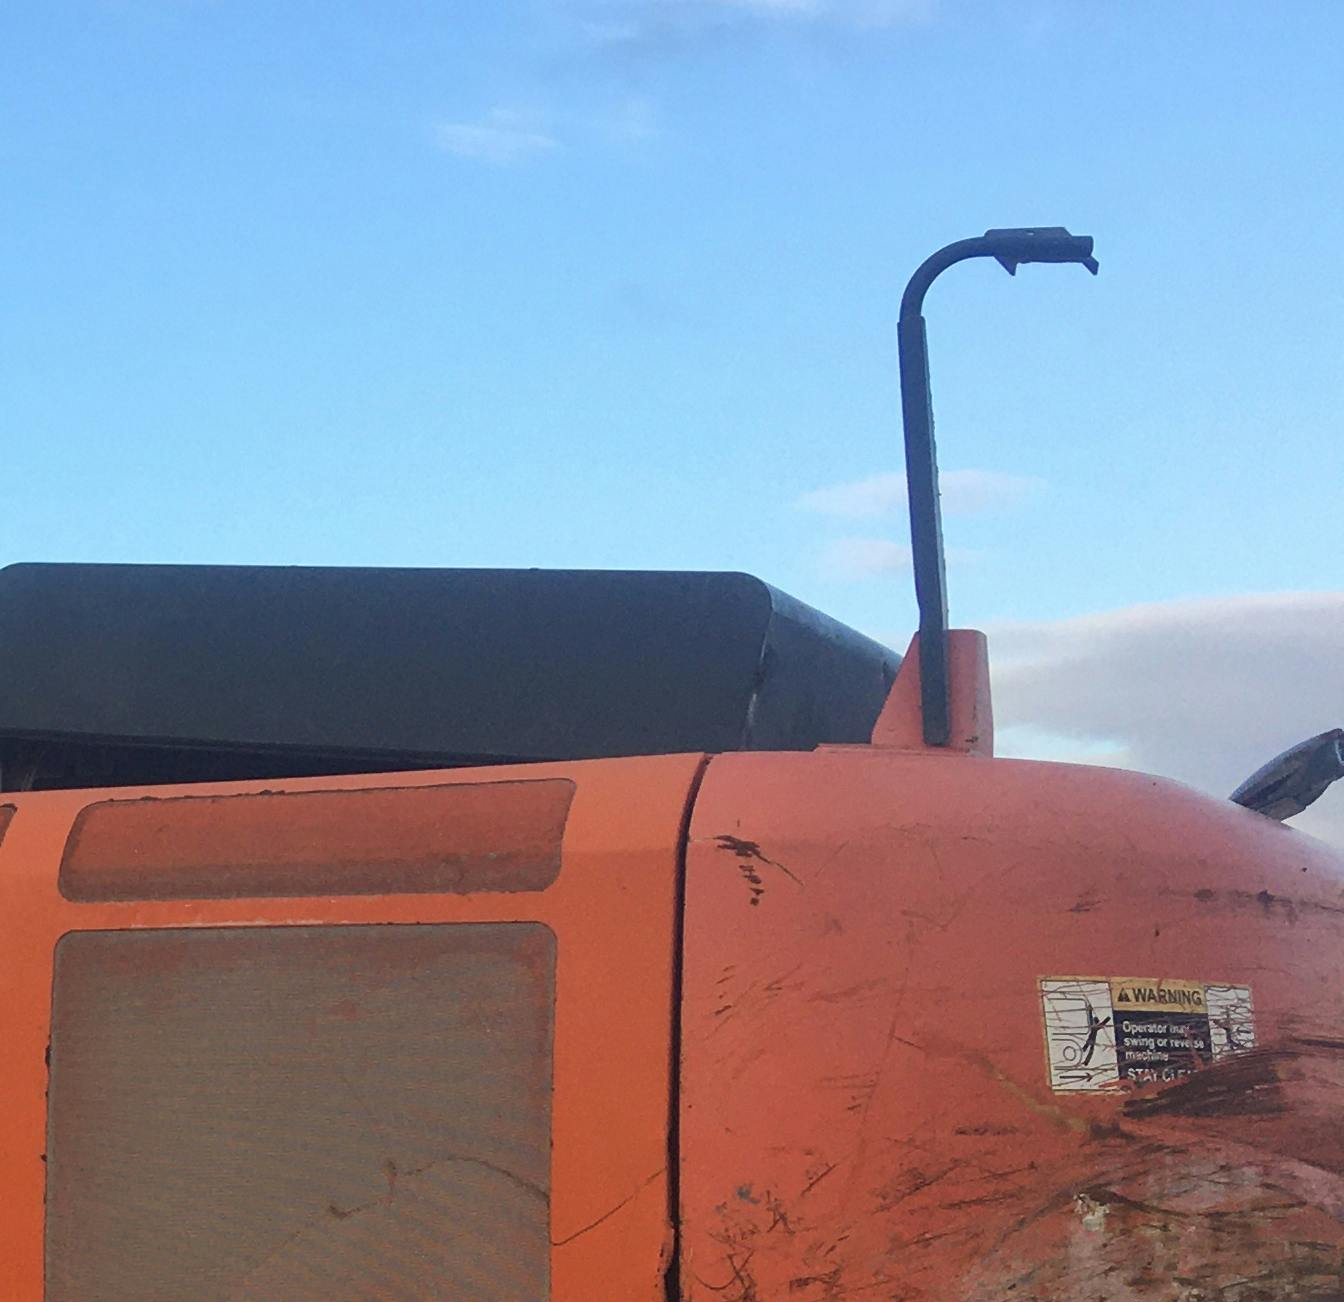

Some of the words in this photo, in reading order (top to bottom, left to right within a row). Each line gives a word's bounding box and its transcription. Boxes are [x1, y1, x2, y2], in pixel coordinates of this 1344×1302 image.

[1132, 987, 1202, 1005] WARNING
[1122, 1020, 1167, 1035] Operator
[1123, 1037, 1155, 1049] swing
[1156, 1039, 1168, 1047] or
